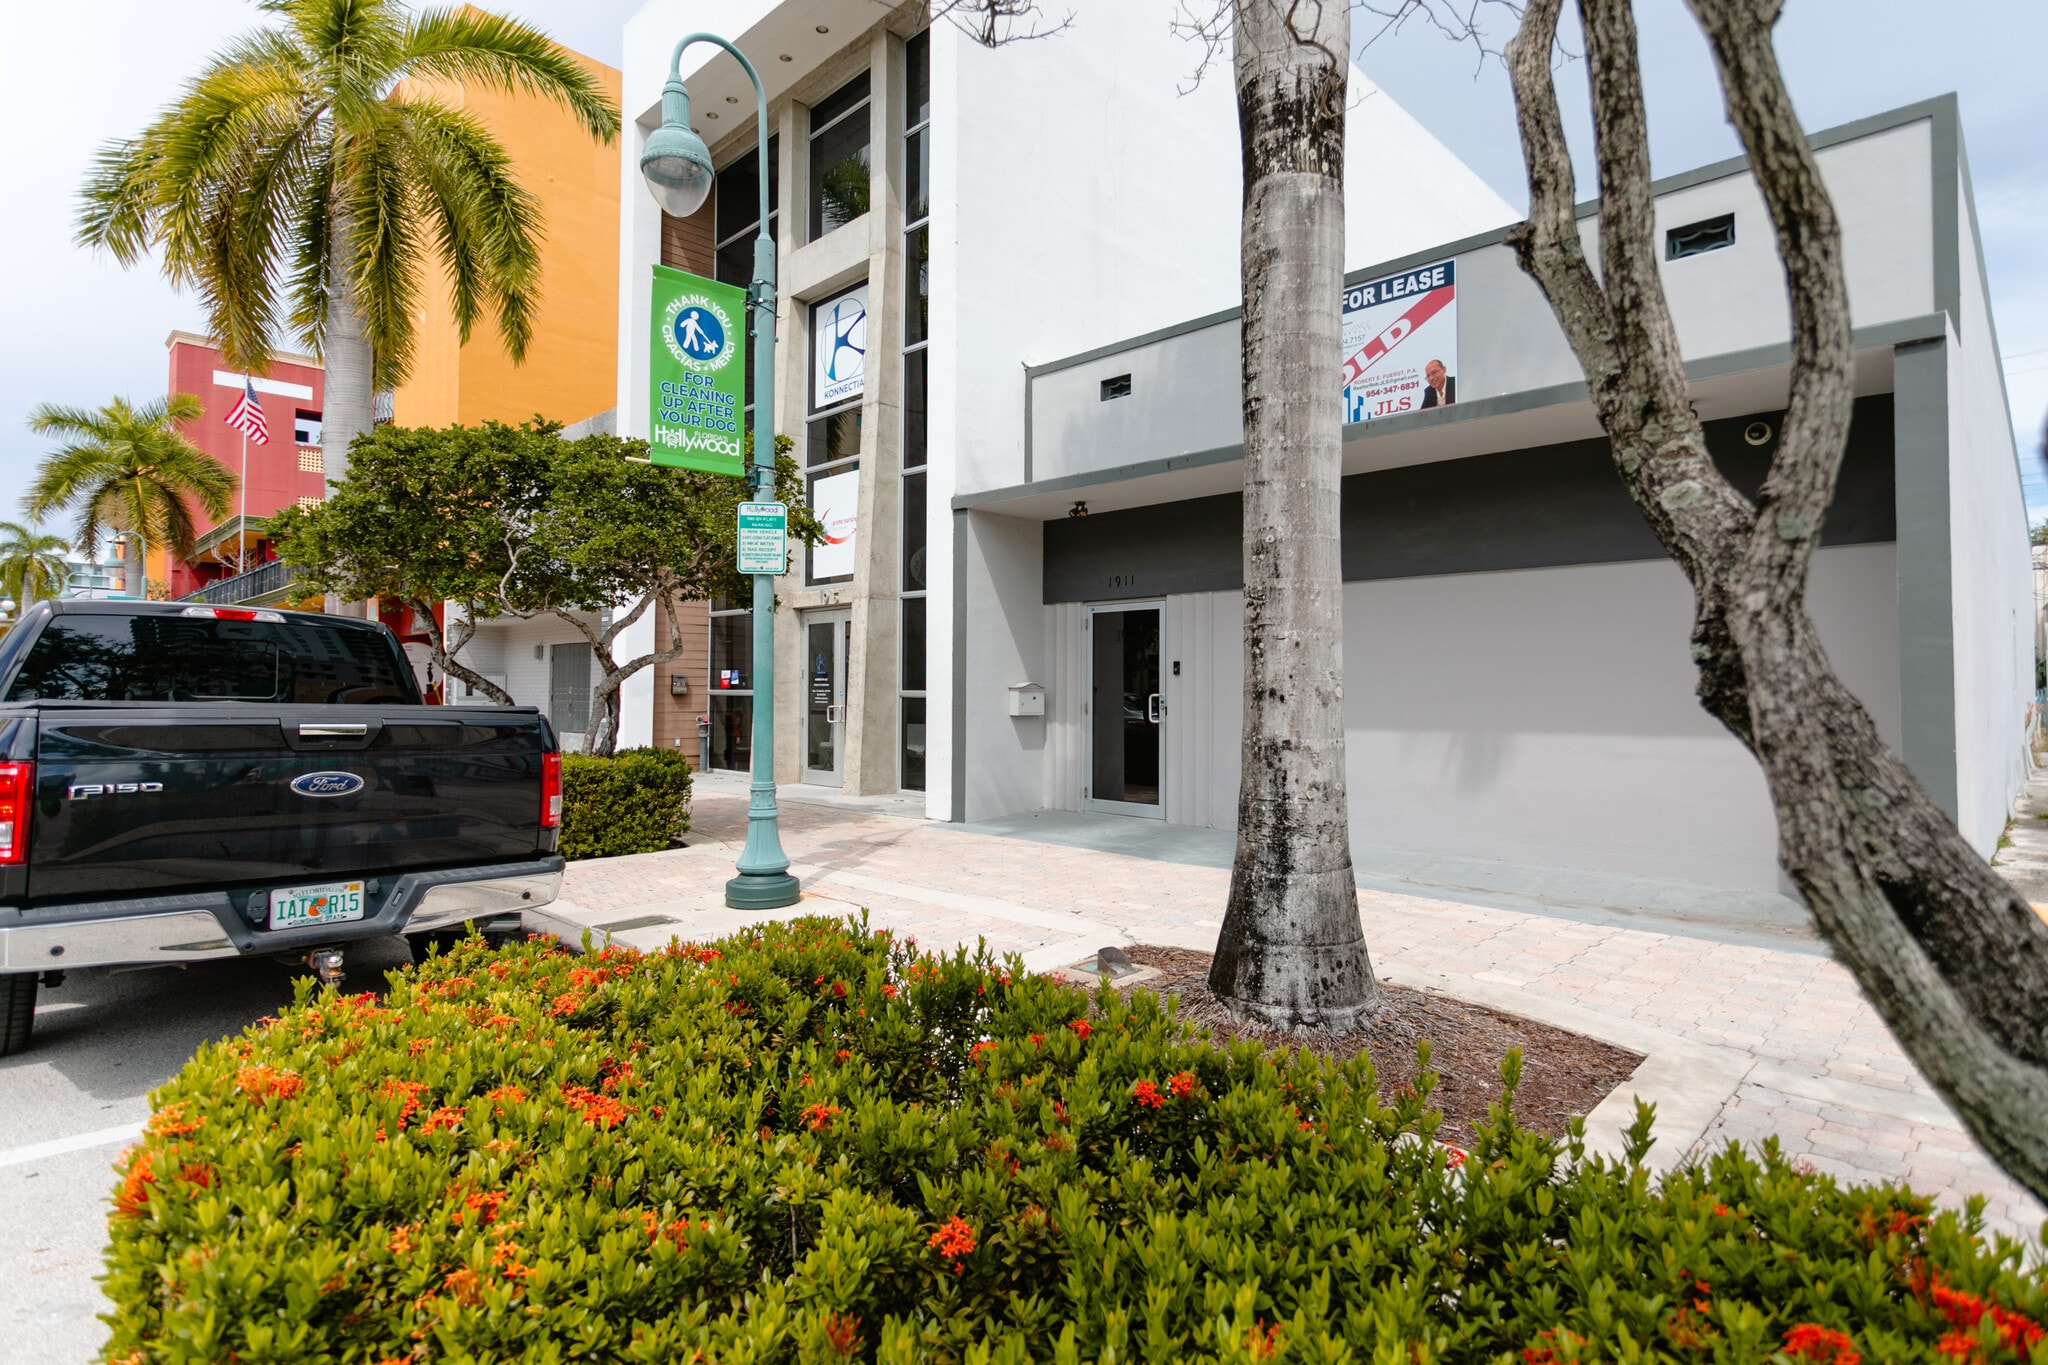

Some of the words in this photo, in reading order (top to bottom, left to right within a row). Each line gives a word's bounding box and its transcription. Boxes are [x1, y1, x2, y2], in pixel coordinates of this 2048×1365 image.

[1381, 266, 1445, 300] LEASE
[665, 294, 709, 315] THANK
[711, 302, 732, 328] YOU
[662, 324, 700, 372] GRACIAS
[709, 341, 735, 371] MERCI
[684, 372, 714, 388] FOR
[1353, 376, 1375, 385] ROBERT
[661, 382, 735, 406] CLEANING
[1374, 396, 1411, 416] JLS
[662, 395, 684, 409] UP
[687, 401, 733, 419] AFTER
[658, 408, 701, 427] YOUR
[705, 417, 736, 433] DOG
[655, 424, 740, 456] Hollywood
[1109, 574, 1134, 588] 1911
[308, 776, 349, 792] Ford
